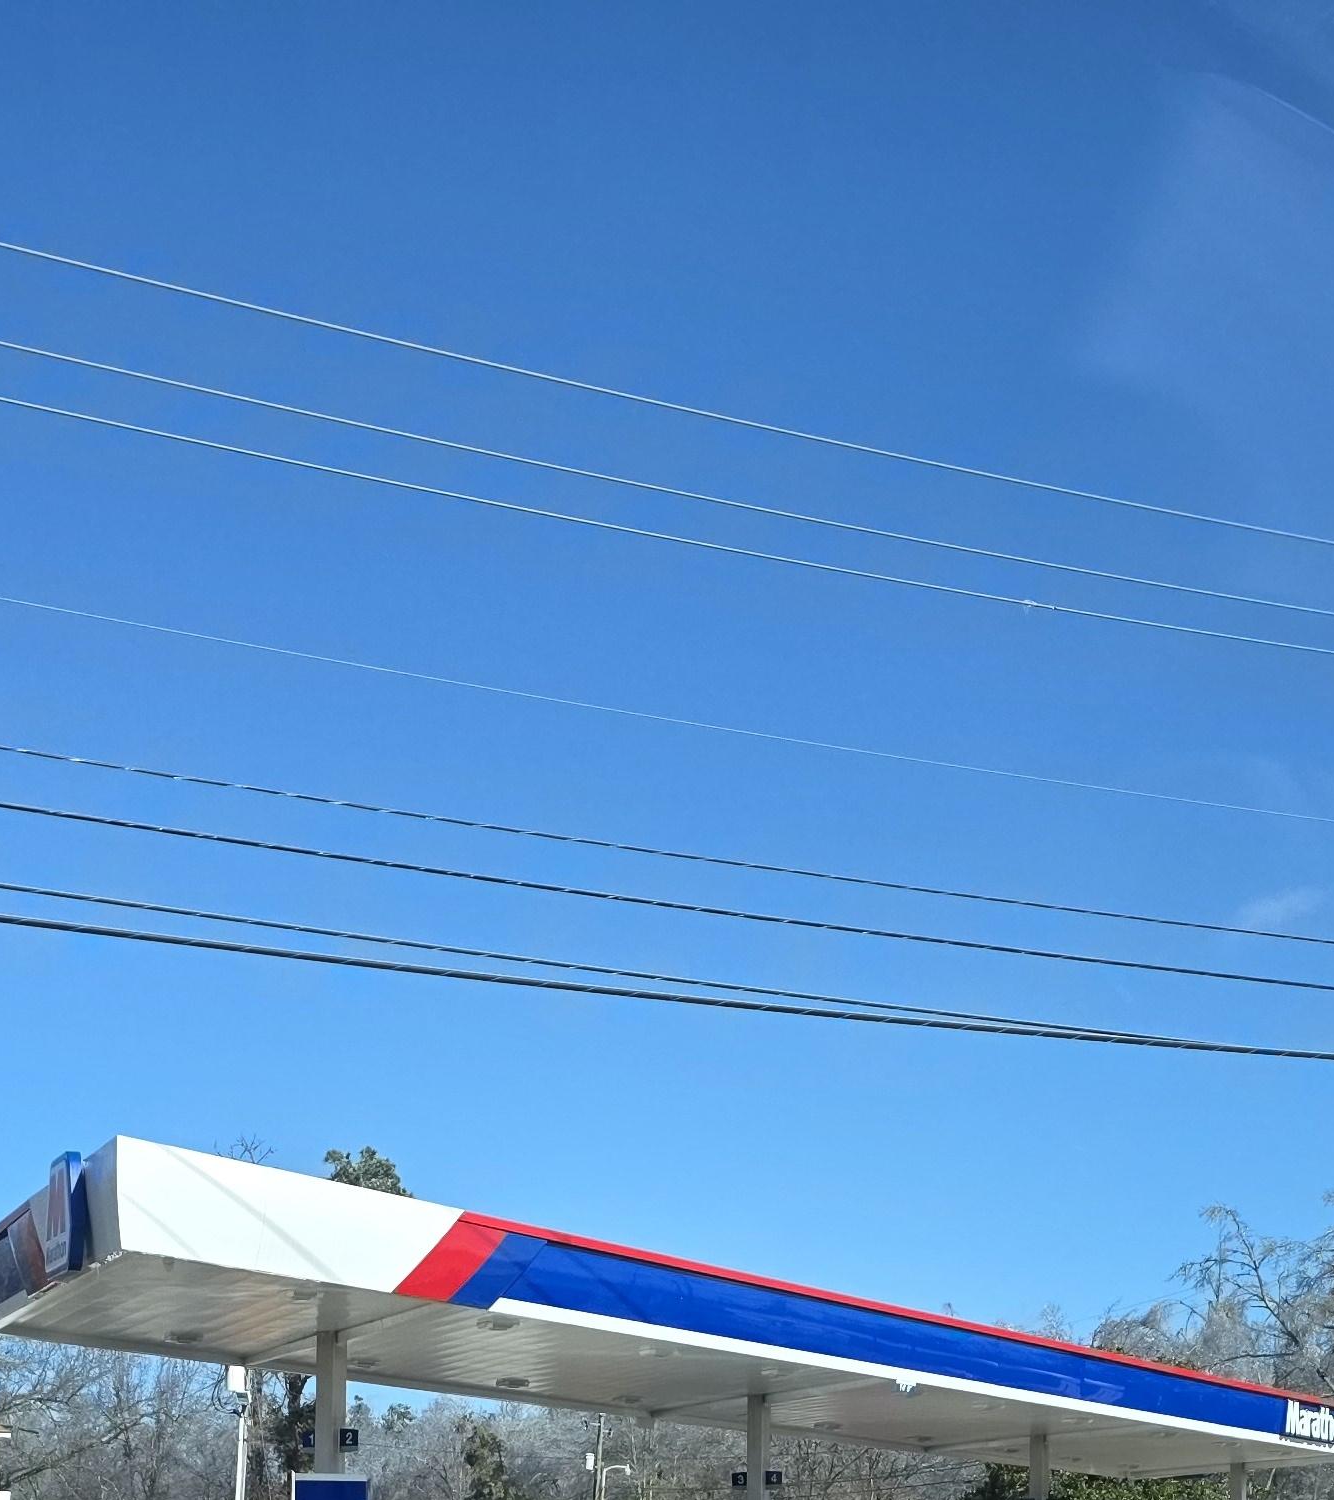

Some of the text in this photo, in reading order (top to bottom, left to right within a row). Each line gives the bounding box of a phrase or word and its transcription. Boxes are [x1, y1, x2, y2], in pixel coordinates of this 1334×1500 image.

[345, 1432, 353, 1444] 2
[737, 1474, 744, 1484] 3
[771, 1474, 777, 1483] 4
